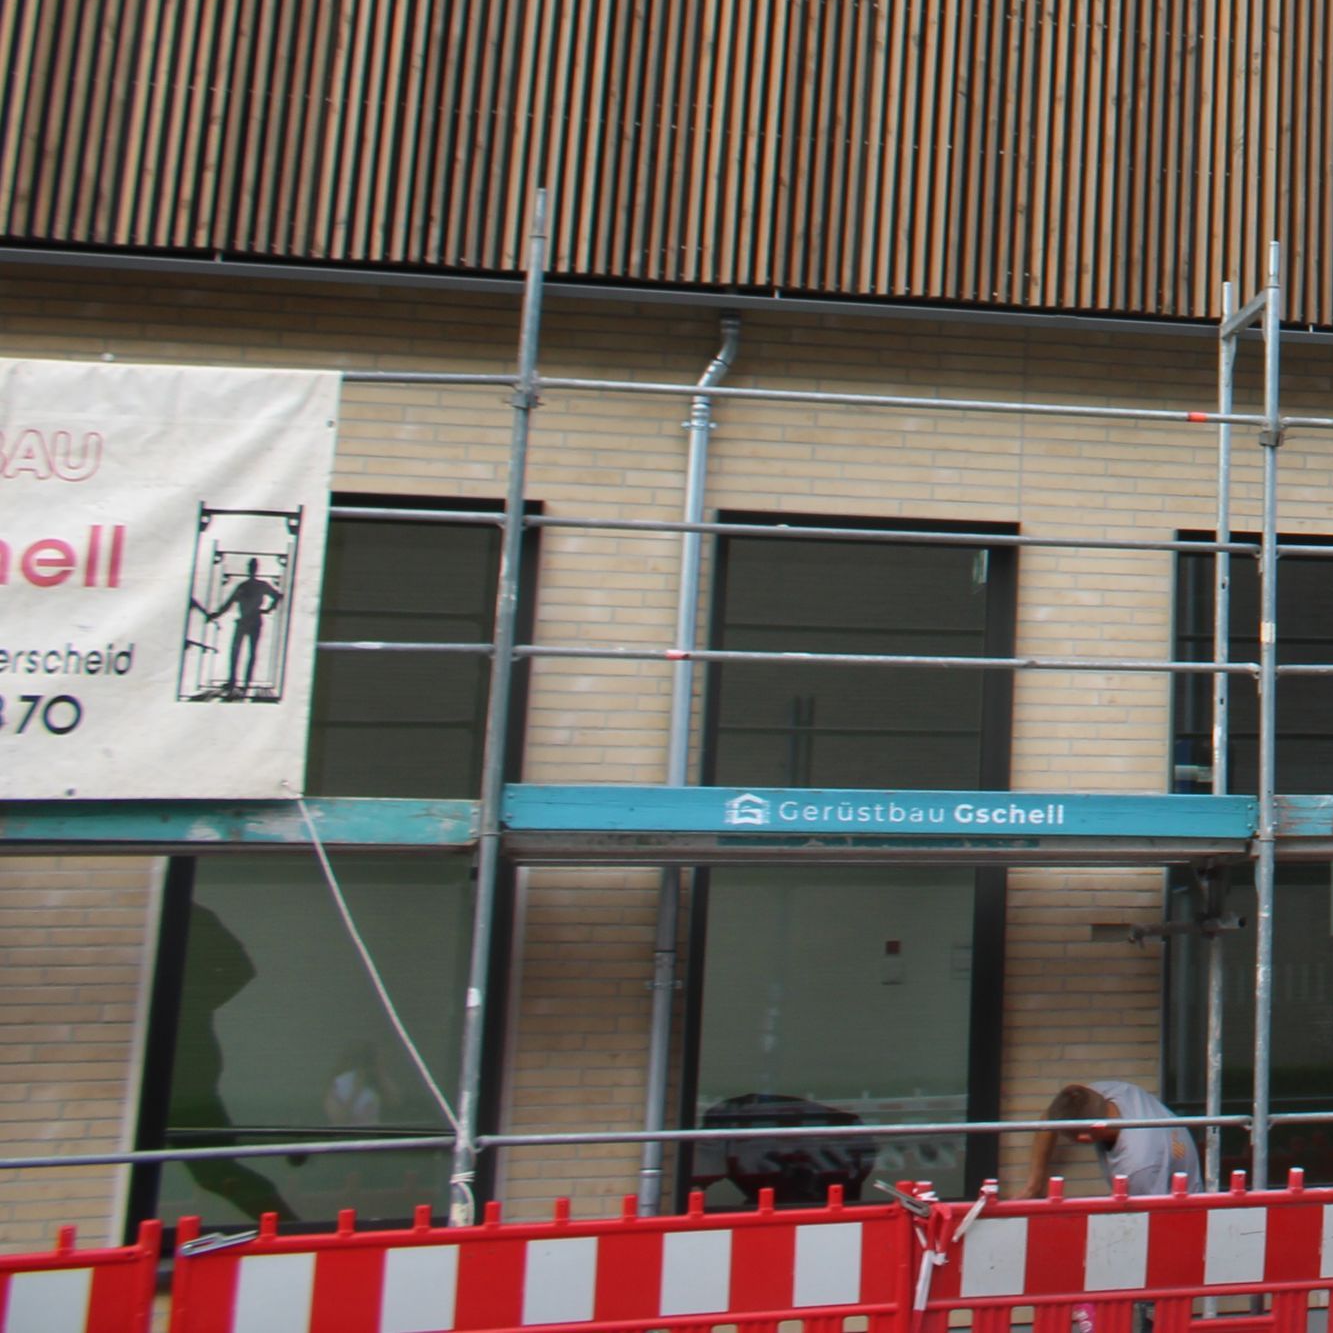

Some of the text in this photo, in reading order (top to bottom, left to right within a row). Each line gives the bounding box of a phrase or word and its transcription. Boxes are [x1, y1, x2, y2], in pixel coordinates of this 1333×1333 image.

[0, 429, 103, 482] AU
[0, 694, 83, 735] 70
[778, 800, 1064, 825] Gerüstbau Gschell
